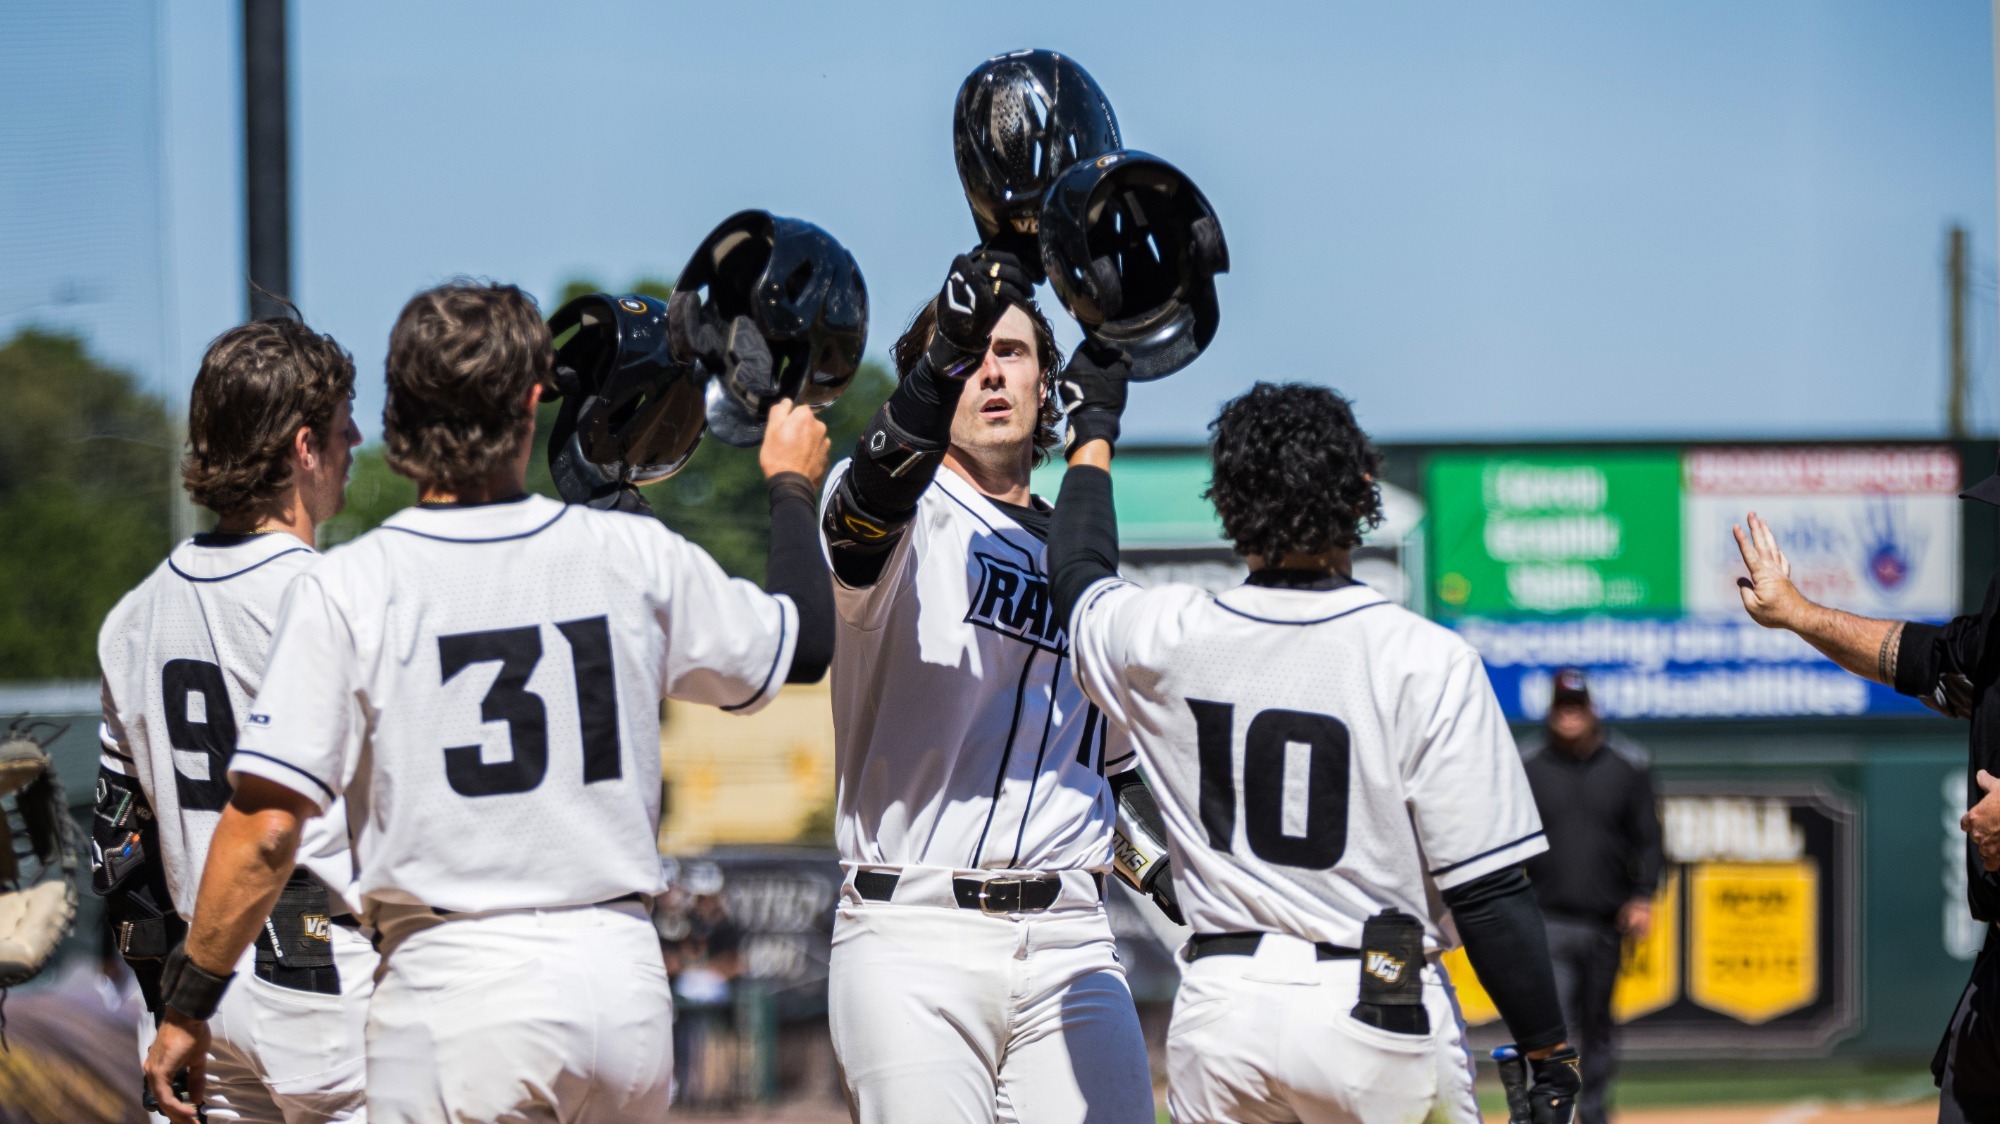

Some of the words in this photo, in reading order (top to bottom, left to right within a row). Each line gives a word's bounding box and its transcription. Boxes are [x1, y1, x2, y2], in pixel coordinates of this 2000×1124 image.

[1012, 218, 1039, 234] VC
[162, 658, 237, 811] 9
[437, 614, 623, 797] 31
[1184, 697, 1349, 871] 10
[1113, 831, 1148, 873] AMS
[1366, 950, 1406, 983] VCU
